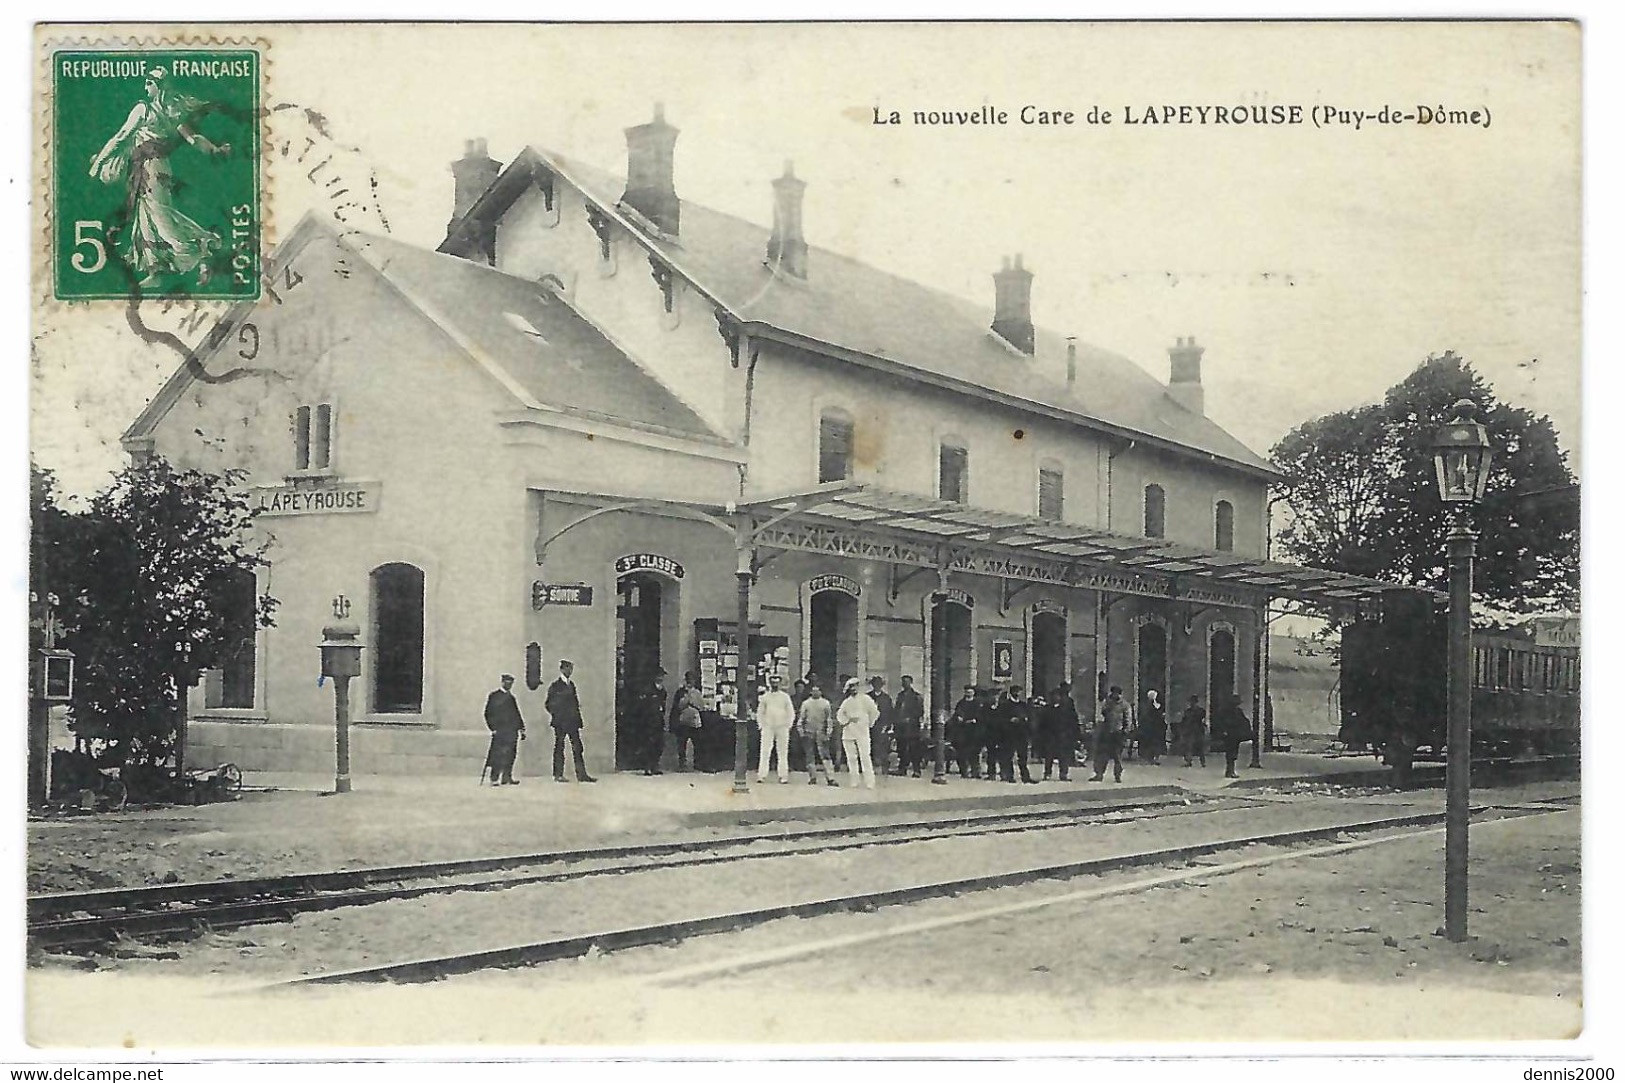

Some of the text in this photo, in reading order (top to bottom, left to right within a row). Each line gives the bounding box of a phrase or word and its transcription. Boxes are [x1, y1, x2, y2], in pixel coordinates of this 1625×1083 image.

[172, 60, 250, 79] FRANÇAISE
[232, 204, 250, 283] POSTES
[260, 490, 366, 512] LAPEYROUSE
[640, 555, 678, 575] CLASSE
